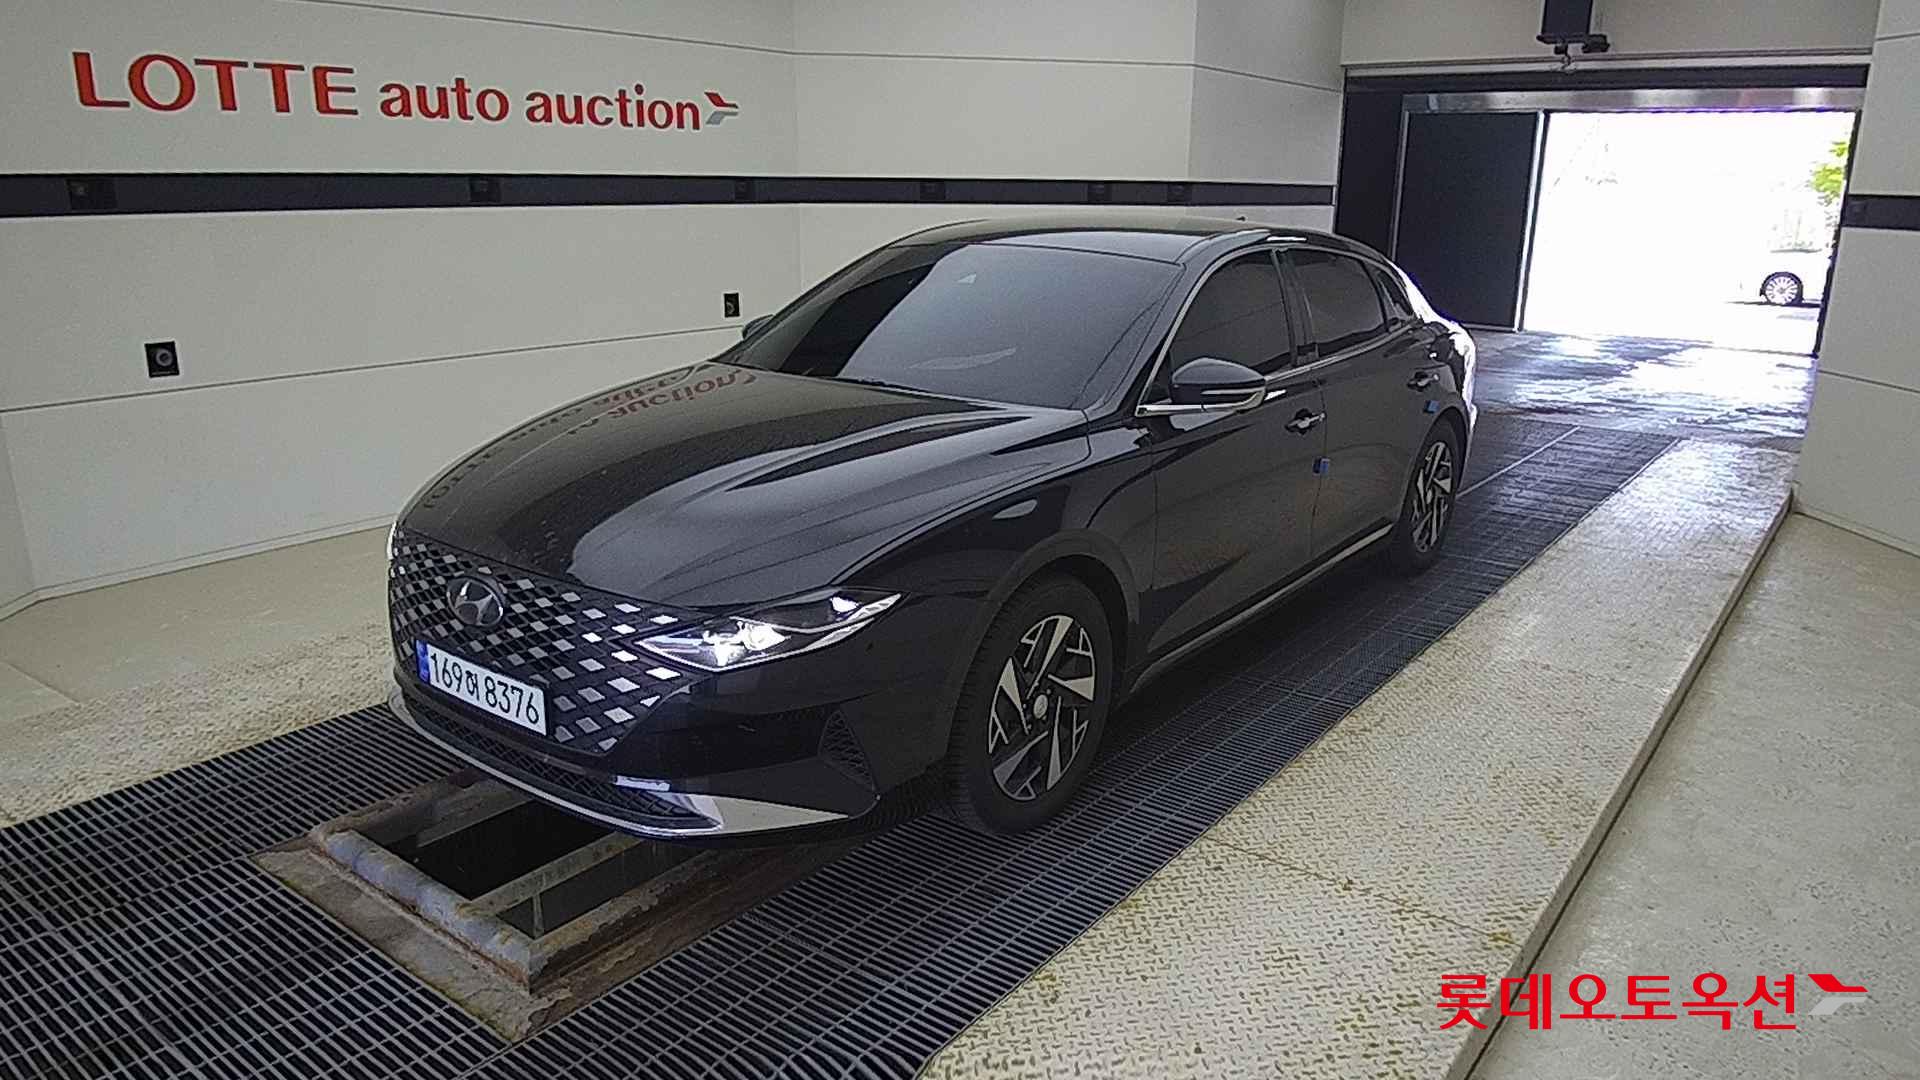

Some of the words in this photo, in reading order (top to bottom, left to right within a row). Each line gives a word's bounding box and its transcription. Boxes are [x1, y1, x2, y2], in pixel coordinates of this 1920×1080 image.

[73, 51, 358, 116] LOTTE
[379, 77, 509, 121] auto
[526, 84, 700, 130] auction
